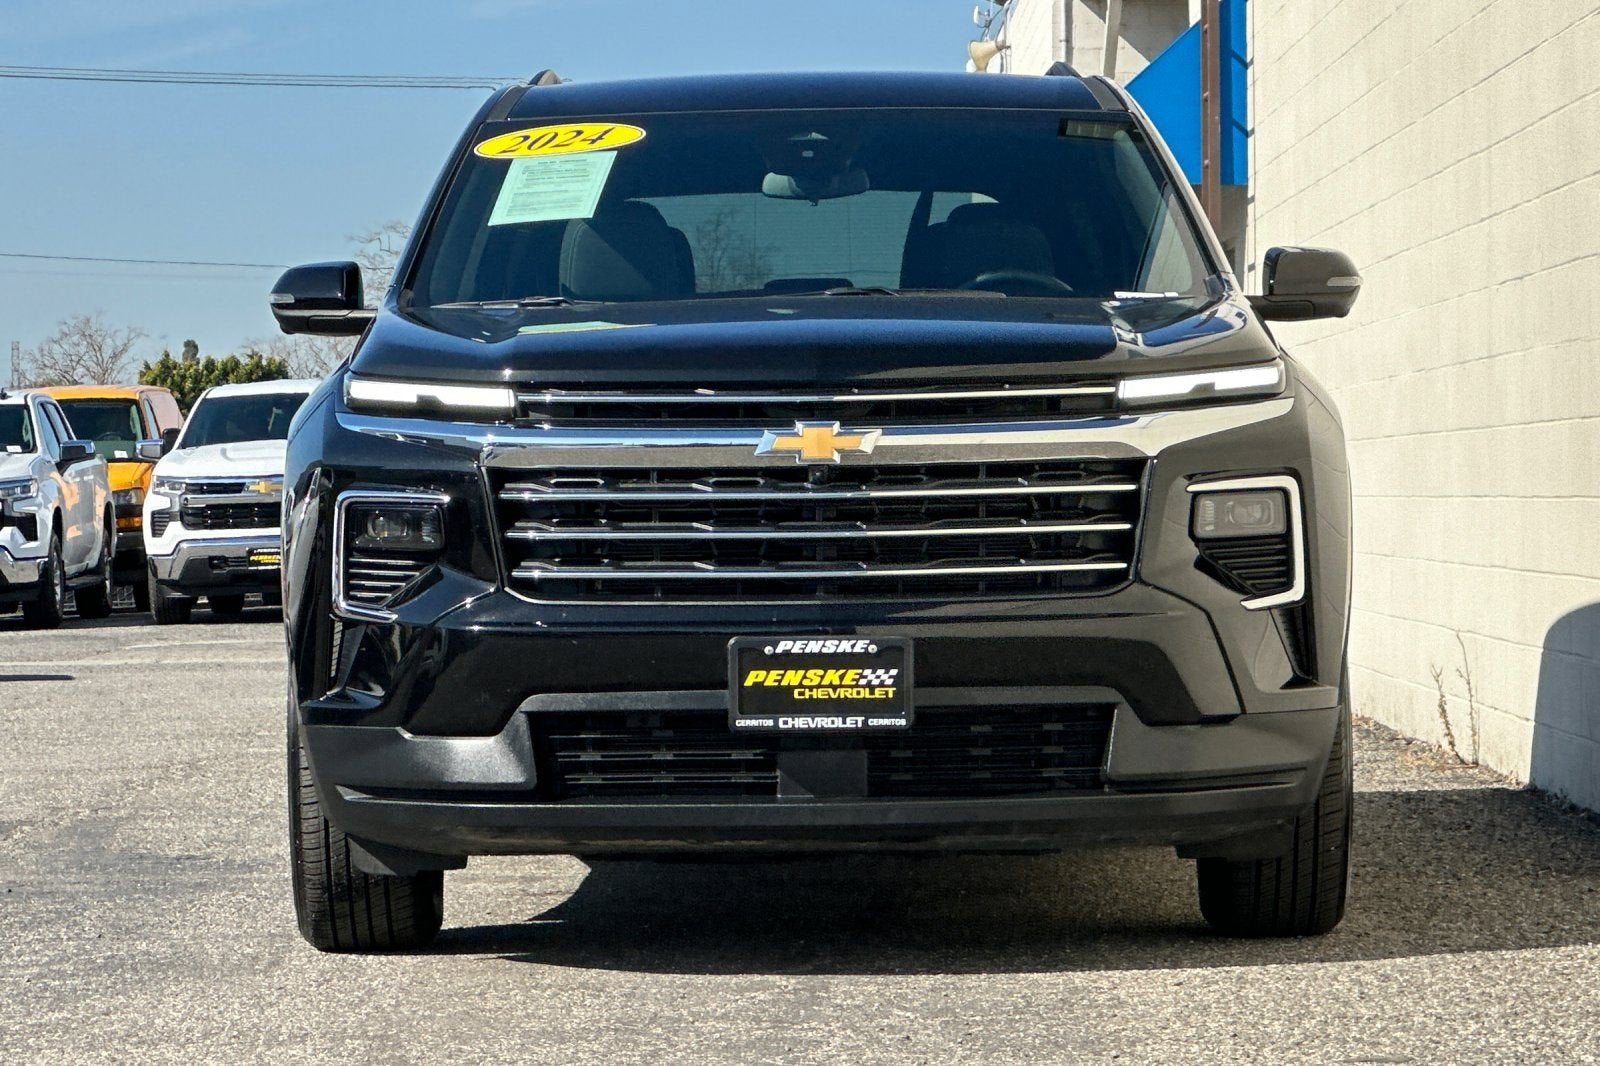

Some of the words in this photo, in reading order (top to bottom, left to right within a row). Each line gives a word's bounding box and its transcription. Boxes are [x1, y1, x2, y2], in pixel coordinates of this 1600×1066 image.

[497, 126, 616, 154] 2024
[775, 640, 870, 653] PENSKE
[743, 668, 863, 686] PENSKE
[793, 688, 896, 699] CHEVROLET
[735, 719, 774, 727] CERRITOS
[778, 716, 865, 728] CHEVROLET
[867, 718, 906, 726] CERRITOS
